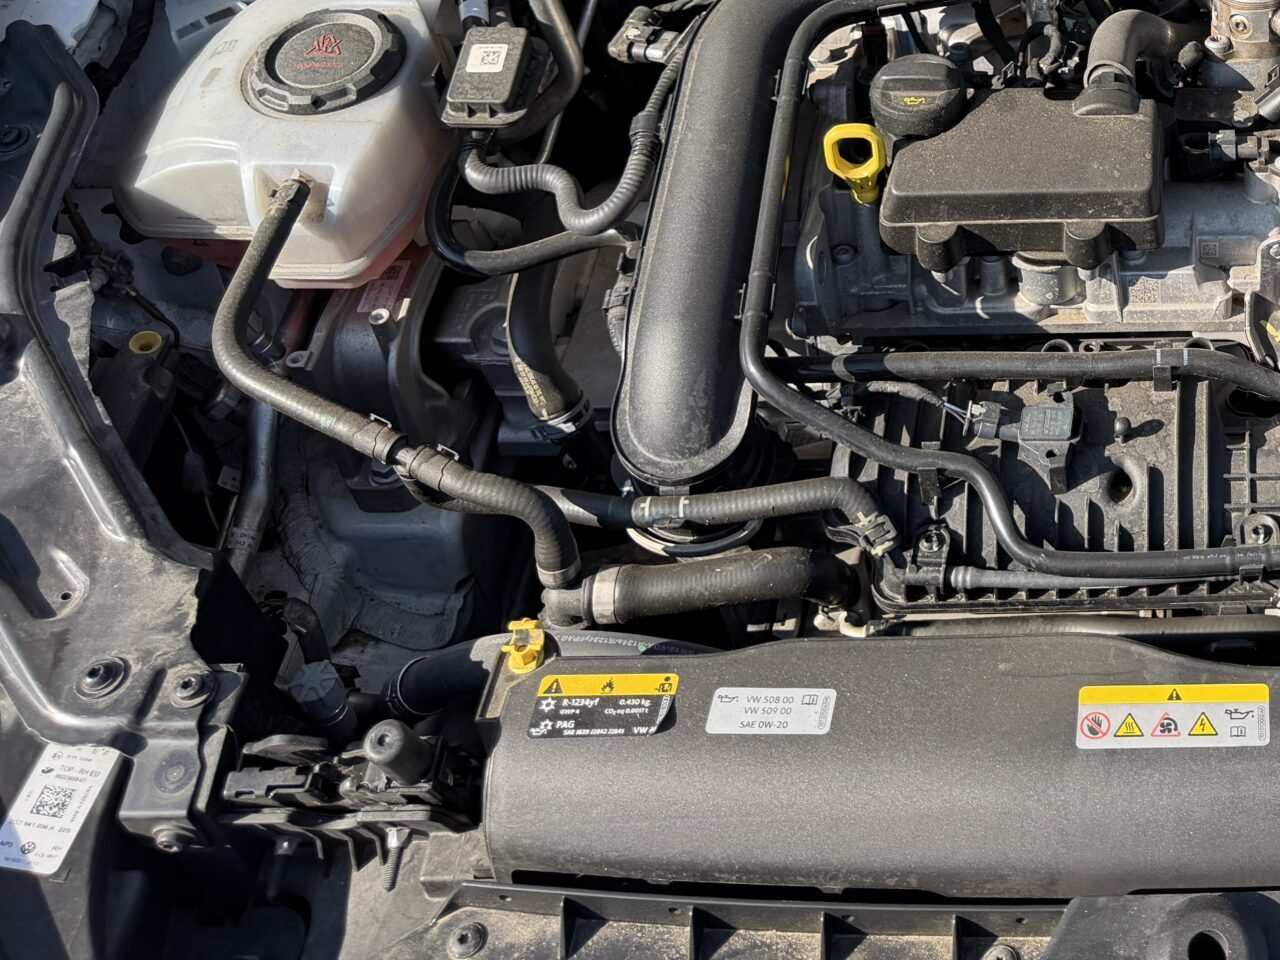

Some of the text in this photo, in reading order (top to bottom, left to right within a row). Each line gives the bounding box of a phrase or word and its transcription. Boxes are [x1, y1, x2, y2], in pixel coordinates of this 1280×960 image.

[561, 697, 600, 708] R-1234yf
[619, 698, 640, 706] 0.430
[746, 696, 794, 704] VW 508 00
[744, 706, 792, 715] VW 509 00
[556, 720, 575, 729] PAG
[739, 720, 789, 729] SAE 0W-20
[563, 728, 575, 736] SAE
[633, 726, 648, 734] VW
[60, 764, 75, 773] TOP
[89, 770, 101, 778] EU
